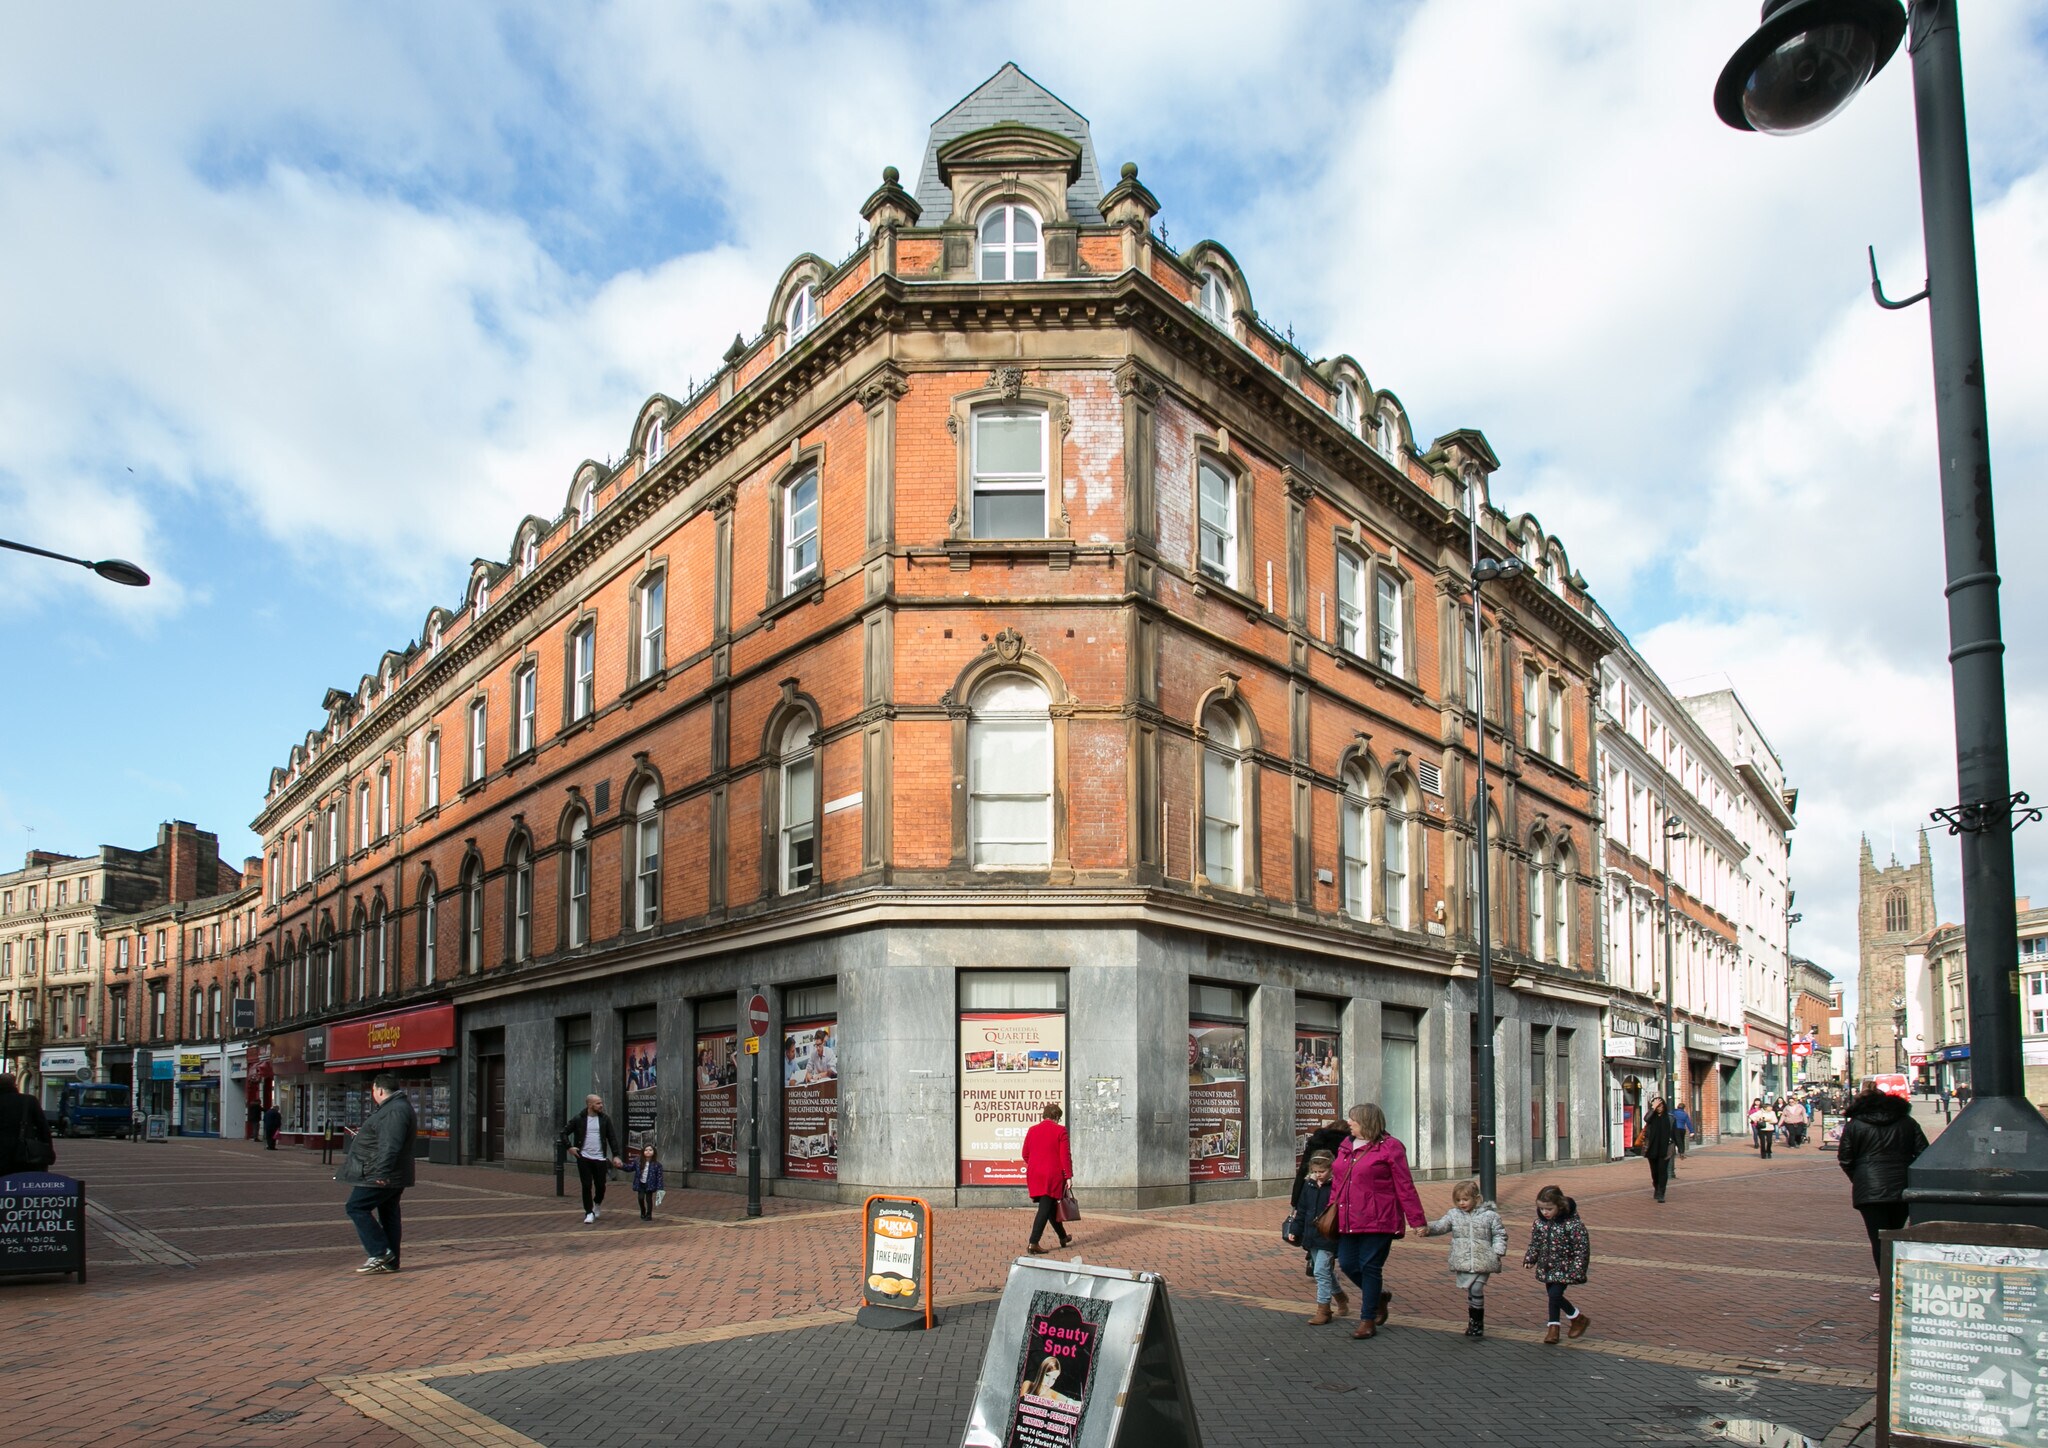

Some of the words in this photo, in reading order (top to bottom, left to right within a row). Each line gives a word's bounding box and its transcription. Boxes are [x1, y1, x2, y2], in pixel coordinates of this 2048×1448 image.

[1613, 1014, 1638, 1036] KIERAN
[1638, 1022, 1660, 1041] MULLIN
[985, 1032, 1040, 1044] QUARTER
[963, 1090, 996, 1099] PRIME
[1000, 1090, 1025, 1099] UNIT
[1028, 1090, 1041, 1099] TO
[1045, 1090, 1062, 1099] LET
[975, 1113, 1043, 1122] OPPORTUNIT
[22, 1196, 78, 1209] DEPOSIT
[6, 1209, 62, 1222] OPTION
[0, 1220, 76, 1233] VAILABLE
[878, 1218, 914, 1232] PUKKA
[31, 1244, 68, 1252] DETAILS
[876, 1250, 891, 1262] TAKE
[892, 1252, 912, 1264] AWAY
[1942, 1251, 1971, 1262] THE
[1912, 1269, 1944, 1281] The
[1948, 1271, 1994, 1286] Tiger
[1912, 1282, 1996, 1304] HAPPY
[1912, 1298, 1985, 1319] HOUR
[1912, 1316, 1960, 1328] CARLING,
[1964, 1322, 2023, 1334] LANDLORD
[1038, 1322, 1089, 1345] Beauty
[1911, 1325, 1936, 1335] BASS
[1938, 1328, 1954, 1336] OR
[1956, 1330, 2009, 1342] PEDIGREE
[1044, 1339, 1077, 1358] Spot
[1911, 1337, 1992, 1353] WORTHINGTON
[1994, 1346, 2022, 1356] MILD
[1911, 1349, 1980, 1363] STRONGBOW
[1911, 1358, 1970, 1372] THATCHERS
[1911, 1370, 1966, 1384] GUINNESS,
[1967, 1377, 2005, 1389] STELLA
[1910, 1382, 1947, 1393] COORS
[1950, 1387, 1981, 1398] LIGHT
[1024, 1394, 1054, 1407] THREADING
[1058, 1402, 1080, 1413] WAXING
[1910, 1394, 1960, 1408] MAINLINE
[1963, 1401, 2014, 1415] DOUBLES
[1019, 1404, 1048, 1417] MANICURE
[1050, 1411, 1077, 1424] PEDICURE
[1023, 1416, 1044, 1428] TINTING
[1909, 1407, 1960, 1420] PREMIUM
[1962, 1413, 2002, 1426] SPIRITS
[1017, 1425, 1028, 1433] Stall
[1036, 1428, 1054, 1440] (Centre
[1909, 1416, 1951, 1428] LIQUOR
[1953, 1422, 2004, 1436] DOUBLES
[1020, 1434, 1034, 1444] Derby
[1035, 1437, 1053, 1448] Market
